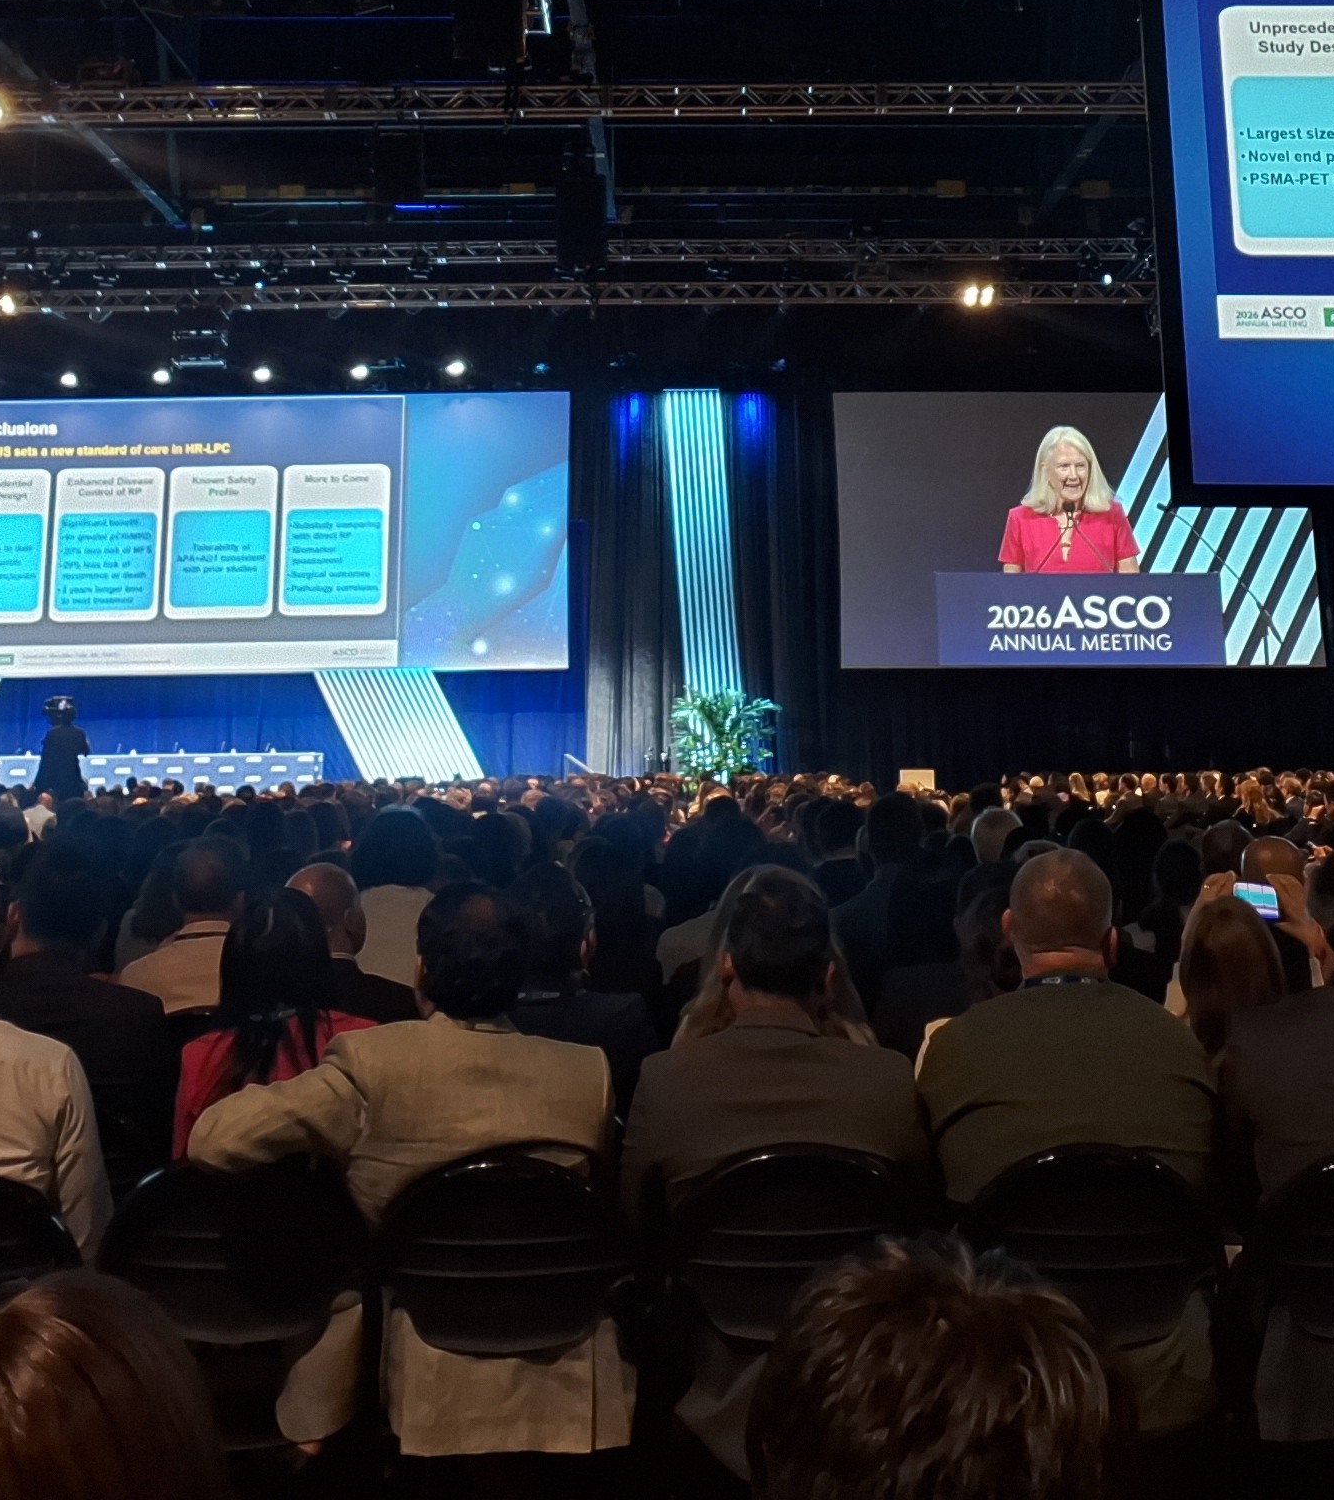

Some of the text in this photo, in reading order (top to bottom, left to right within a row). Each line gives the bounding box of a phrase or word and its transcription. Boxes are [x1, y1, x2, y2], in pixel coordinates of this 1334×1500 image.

[1258, 40, 1305, 57] Study
[1247, 128, 1303, 142] Largest
[1306, 128, 1334, 140] size
[1249, 151, 1289, 162] Novel
[1295, 151, 1321, 162] end
[1250, 173, 1329, 186] PSMA-PET
[1236, 307, 1306, 320] 2026 ASCO
[13, 446, 37, 458] sets
[41, 448, 47, 457] a
[51, 448, 74, 457] new
[77, 444, 126, 456] standard
[130, 444, 143, 456] of
[144, 446, 168, 456] care
[171, 444, 183, 455] in
[185, 443, 229, 455] HR-LPC
[988, 606, 1050, 629] 2026
[989, 634, 1172, 652] ANNUAL MEETING
